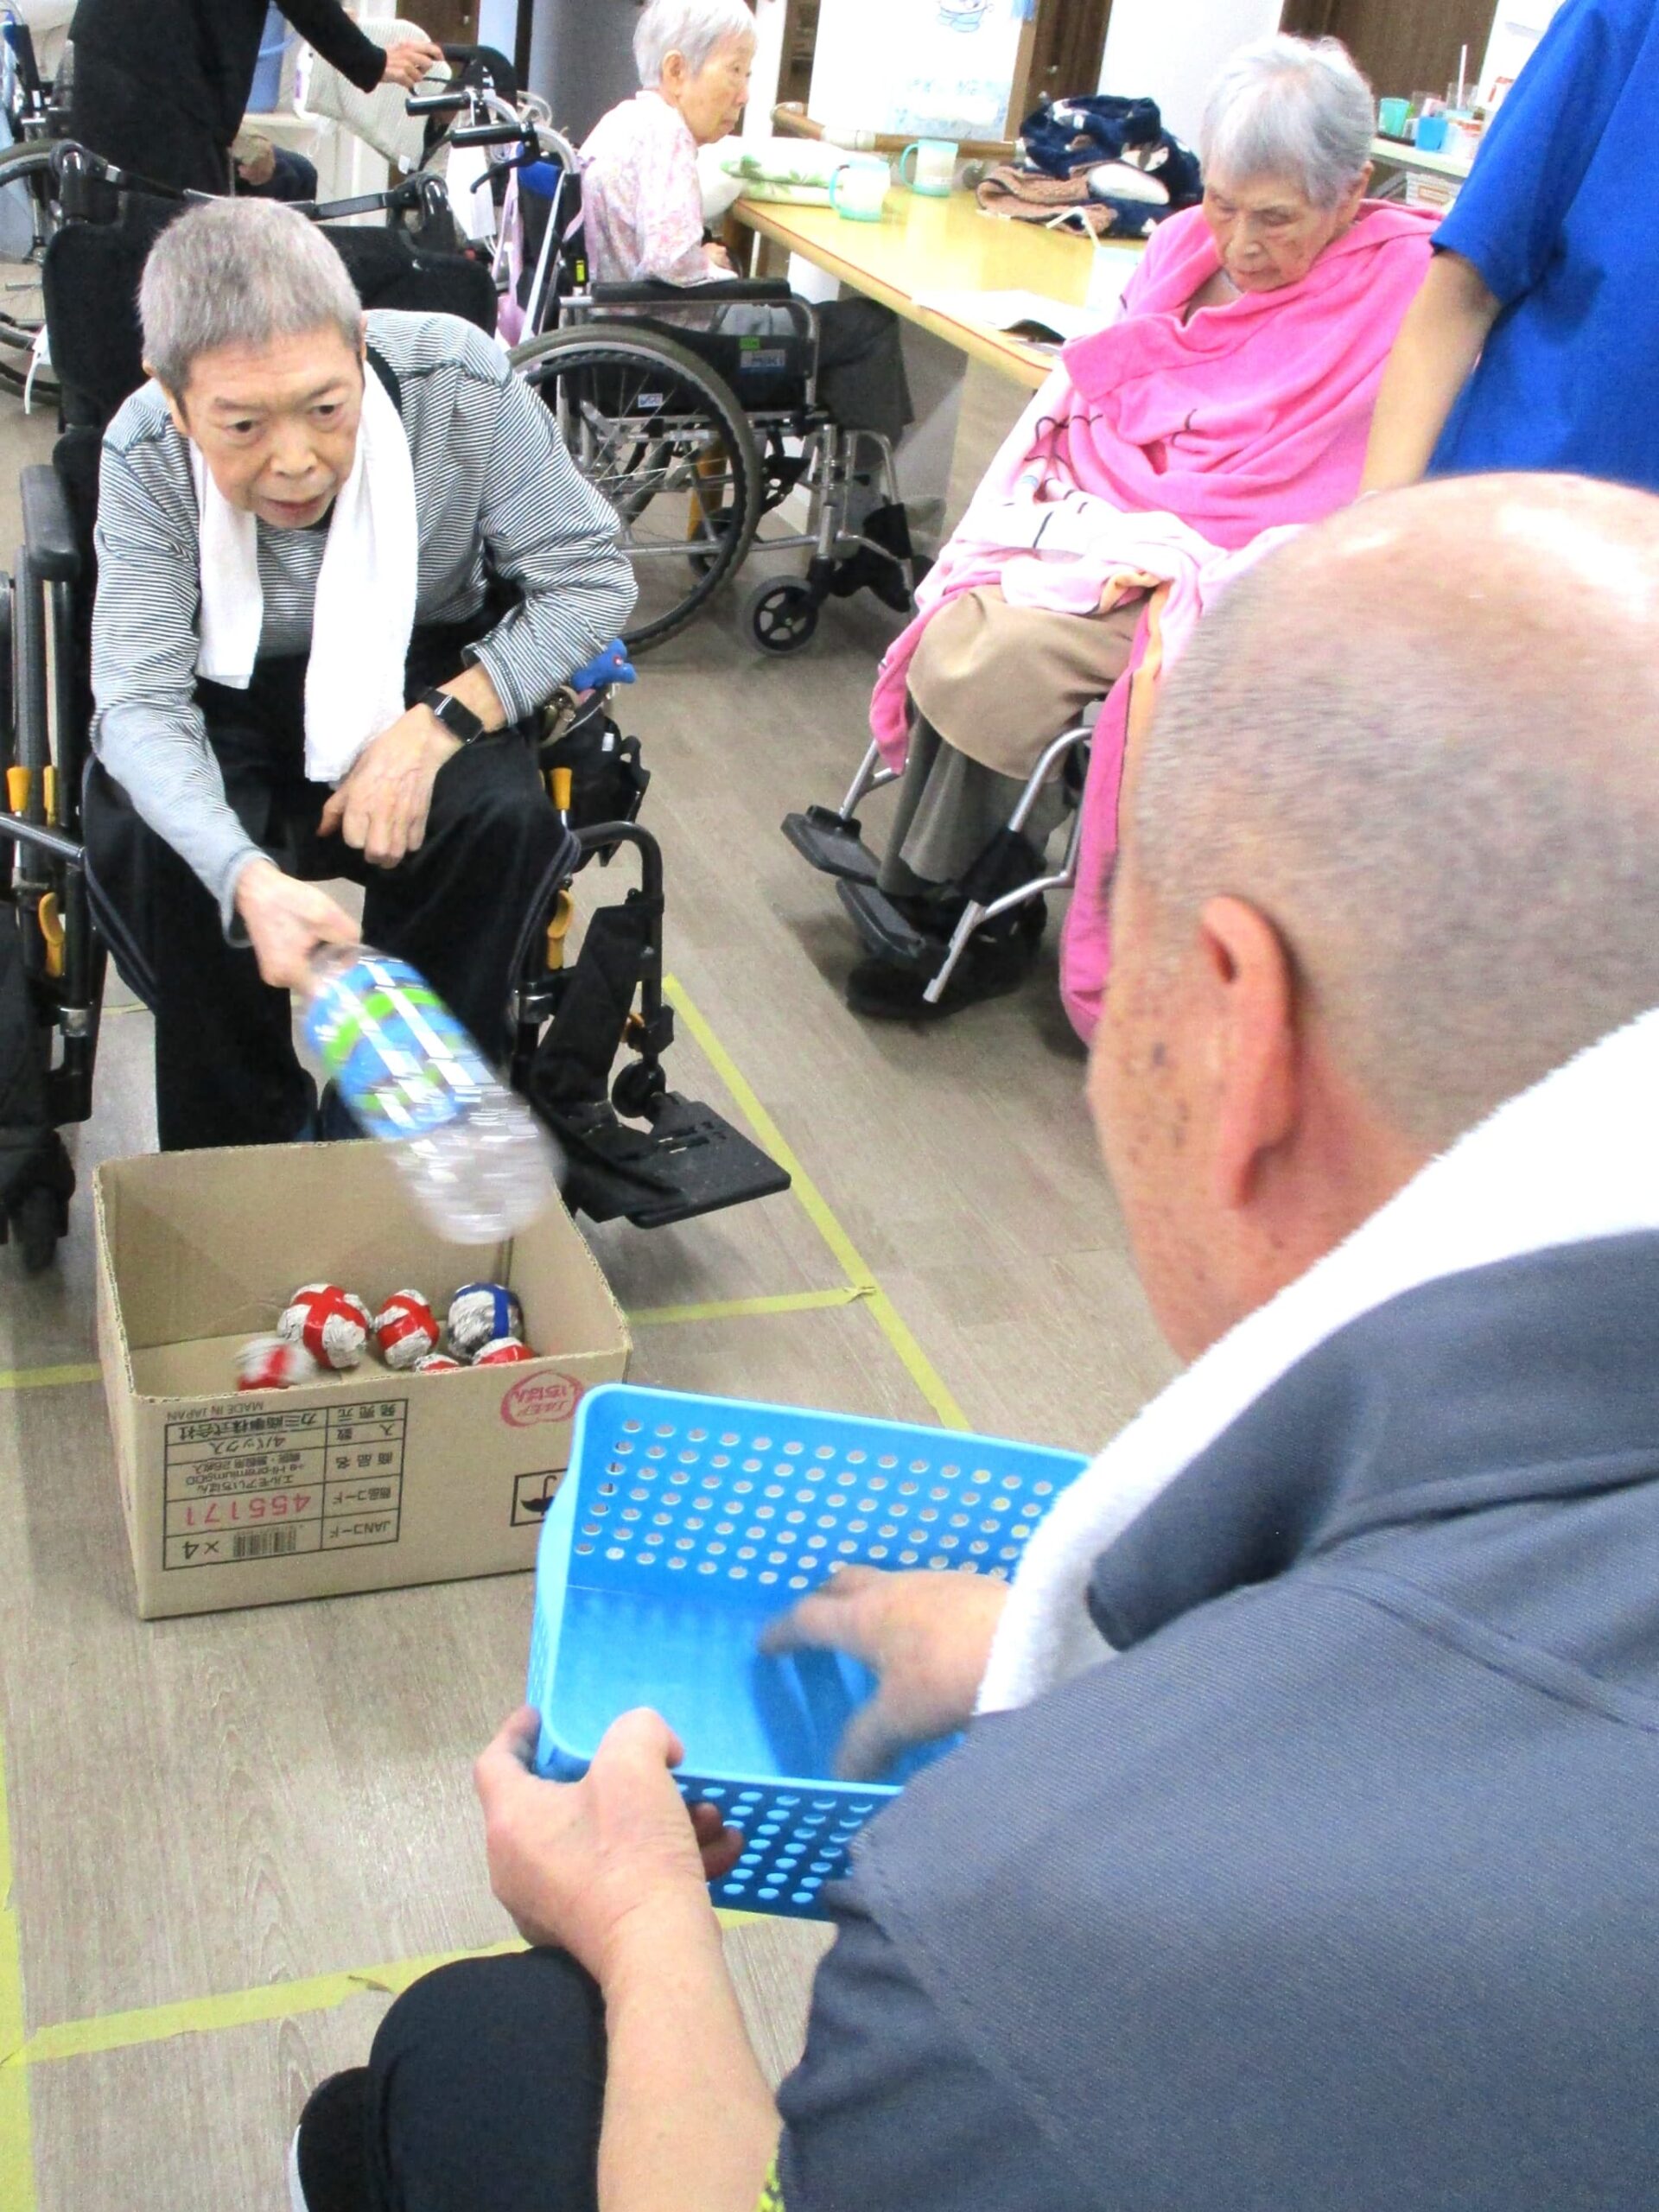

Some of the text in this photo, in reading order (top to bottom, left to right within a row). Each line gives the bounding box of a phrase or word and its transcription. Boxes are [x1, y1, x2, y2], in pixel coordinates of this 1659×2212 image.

[167, 1402, 264, 1421] MADE IN JAPAN
[209, 1435, 286, 1455] 4パック入
[333, 1486, 391, 1504] 商品コード
[183, 1492, 312, 1526] 455171
[329, 1520, 391, 1538] JANコード
